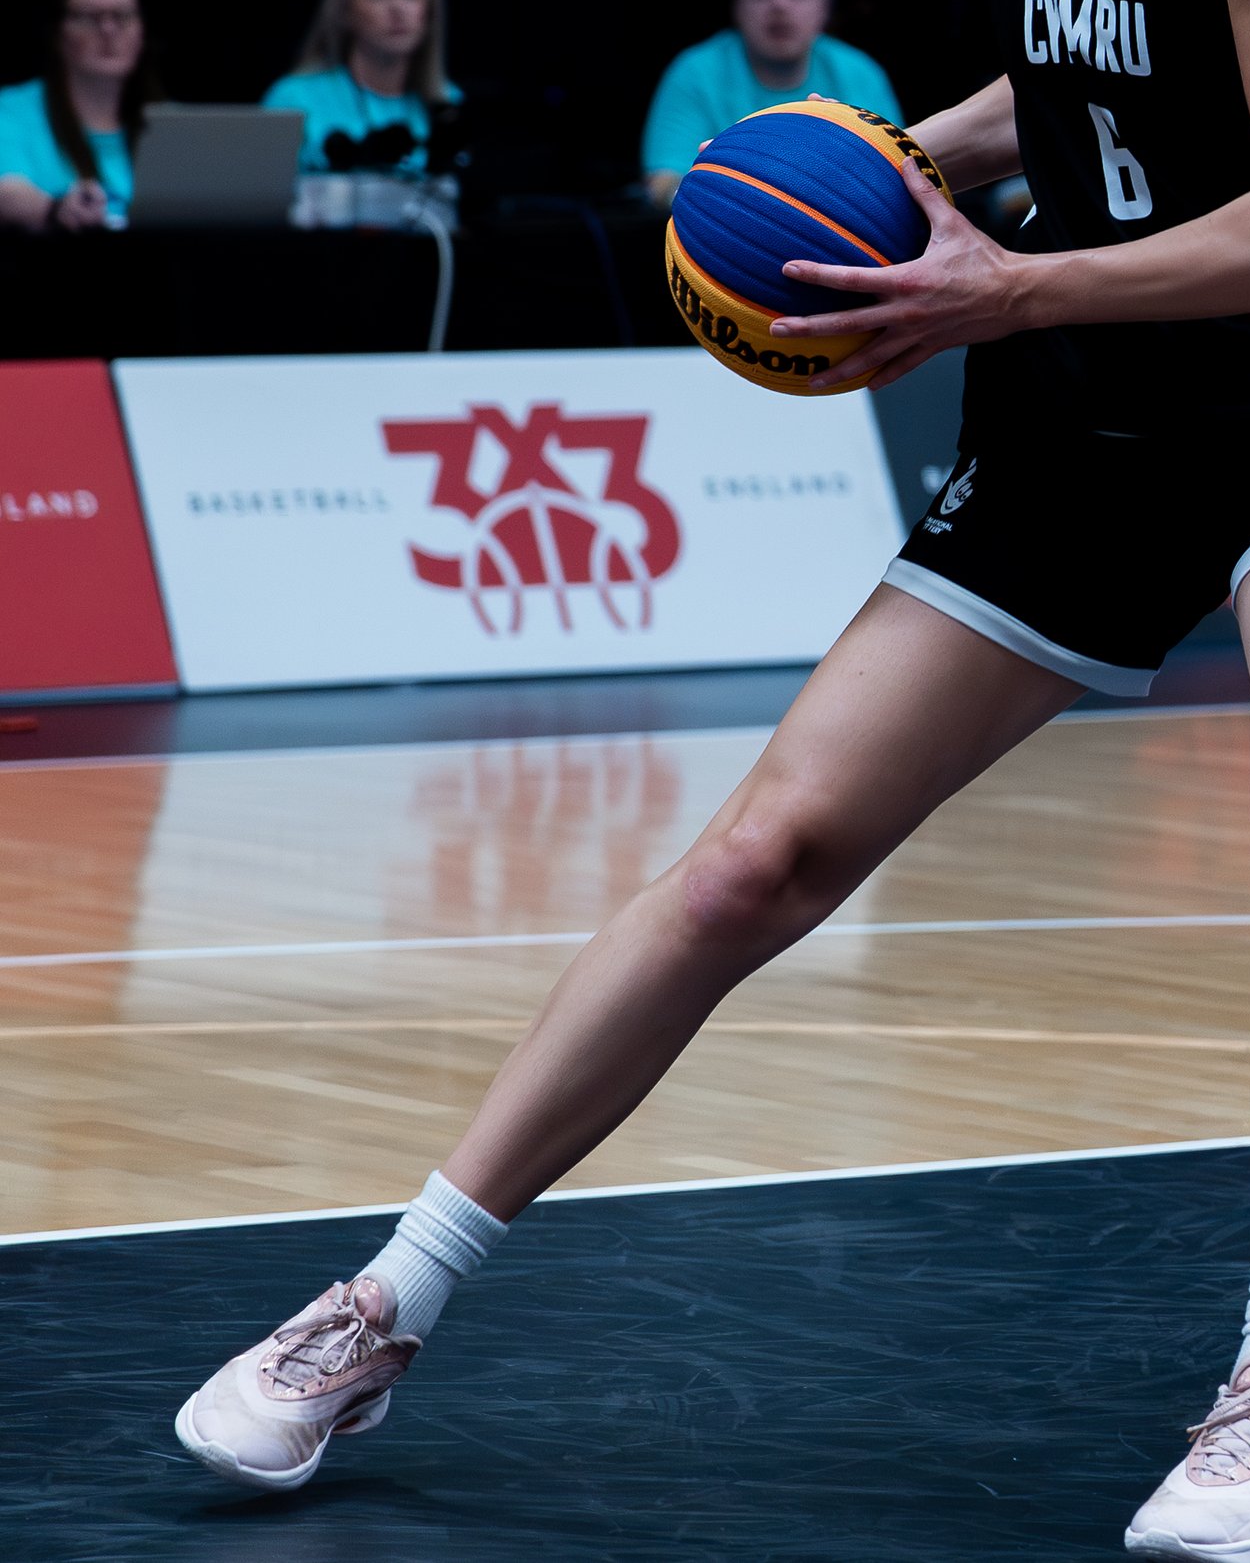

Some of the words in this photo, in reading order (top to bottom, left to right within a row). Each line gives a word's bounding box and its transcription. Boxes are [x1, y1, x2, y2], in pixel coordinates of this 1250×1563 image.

[1087, 102, 1153, 221] 6
[669, 255, 831, 377] Wilson
[0, 489, 99, 521] LAND
